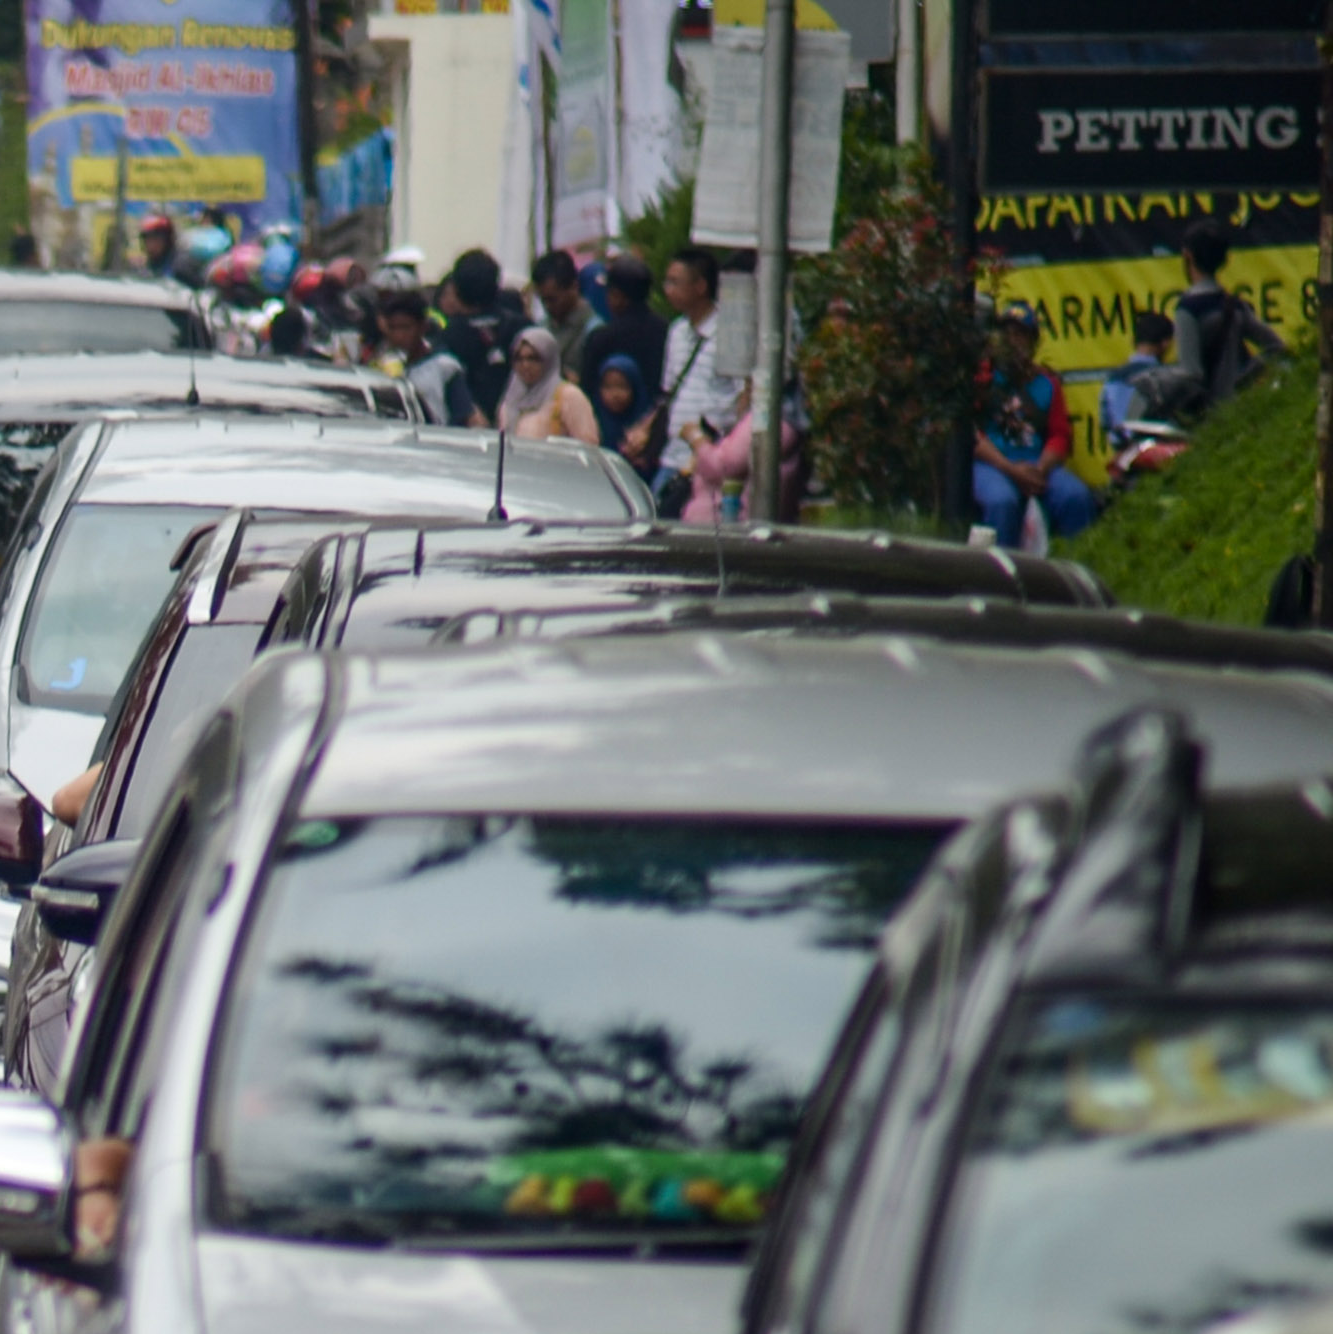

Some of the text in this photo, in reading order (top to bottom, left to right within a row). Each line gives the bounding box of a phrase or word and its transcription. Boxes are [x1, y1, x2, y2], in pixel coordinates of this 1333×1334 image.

[41, 19, 296, 56] Dukungan Renovas
[66, 63, 152, 97] Masjid
[1037, 107, 1300, 152] PETTING
